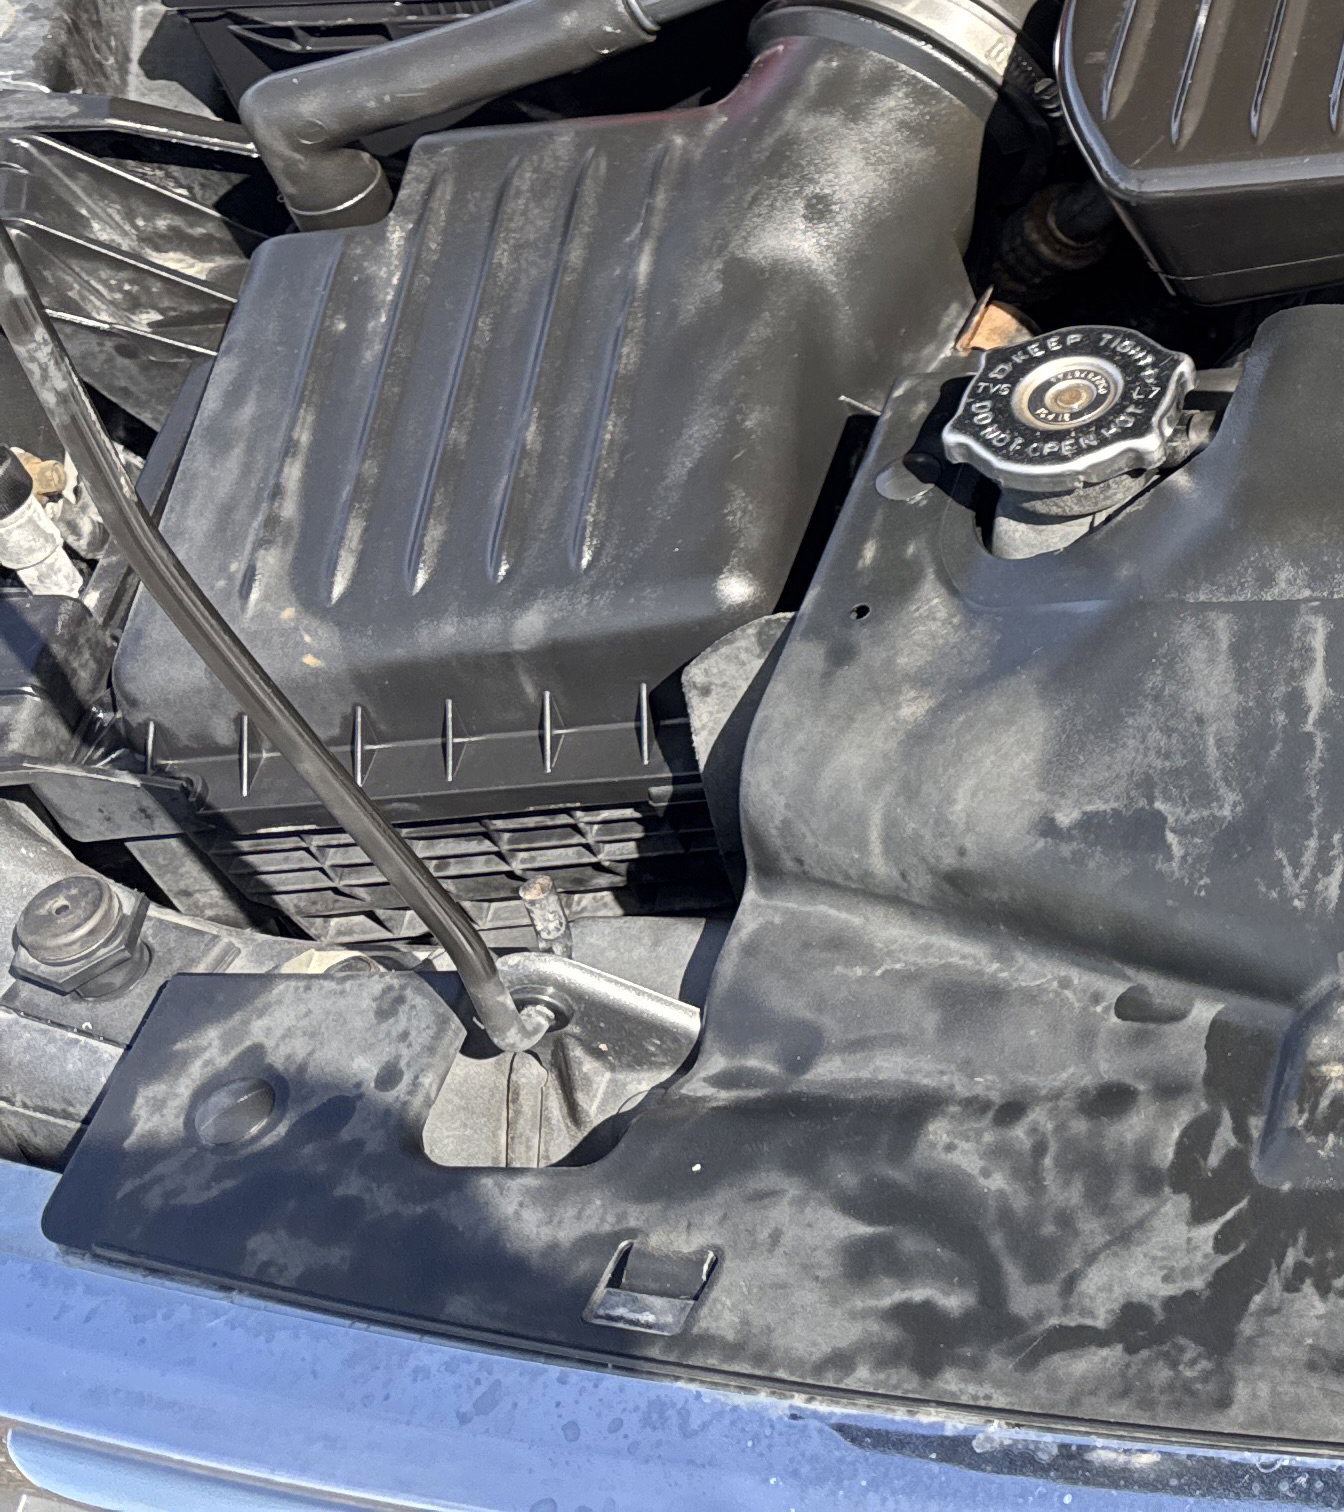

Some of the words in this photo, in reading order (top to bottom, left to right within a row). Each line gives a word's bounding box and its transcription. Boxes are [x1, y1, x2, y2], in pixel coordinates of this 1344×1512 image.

[1011, 333, 1083, 364] KEEP
[1099, 333, 1155, 367] TIGHT
[971, 399, 995, 426] DO
[1027, 432, 1099, 458] OPEN
[1100, 404, 1145, 438] HOT
